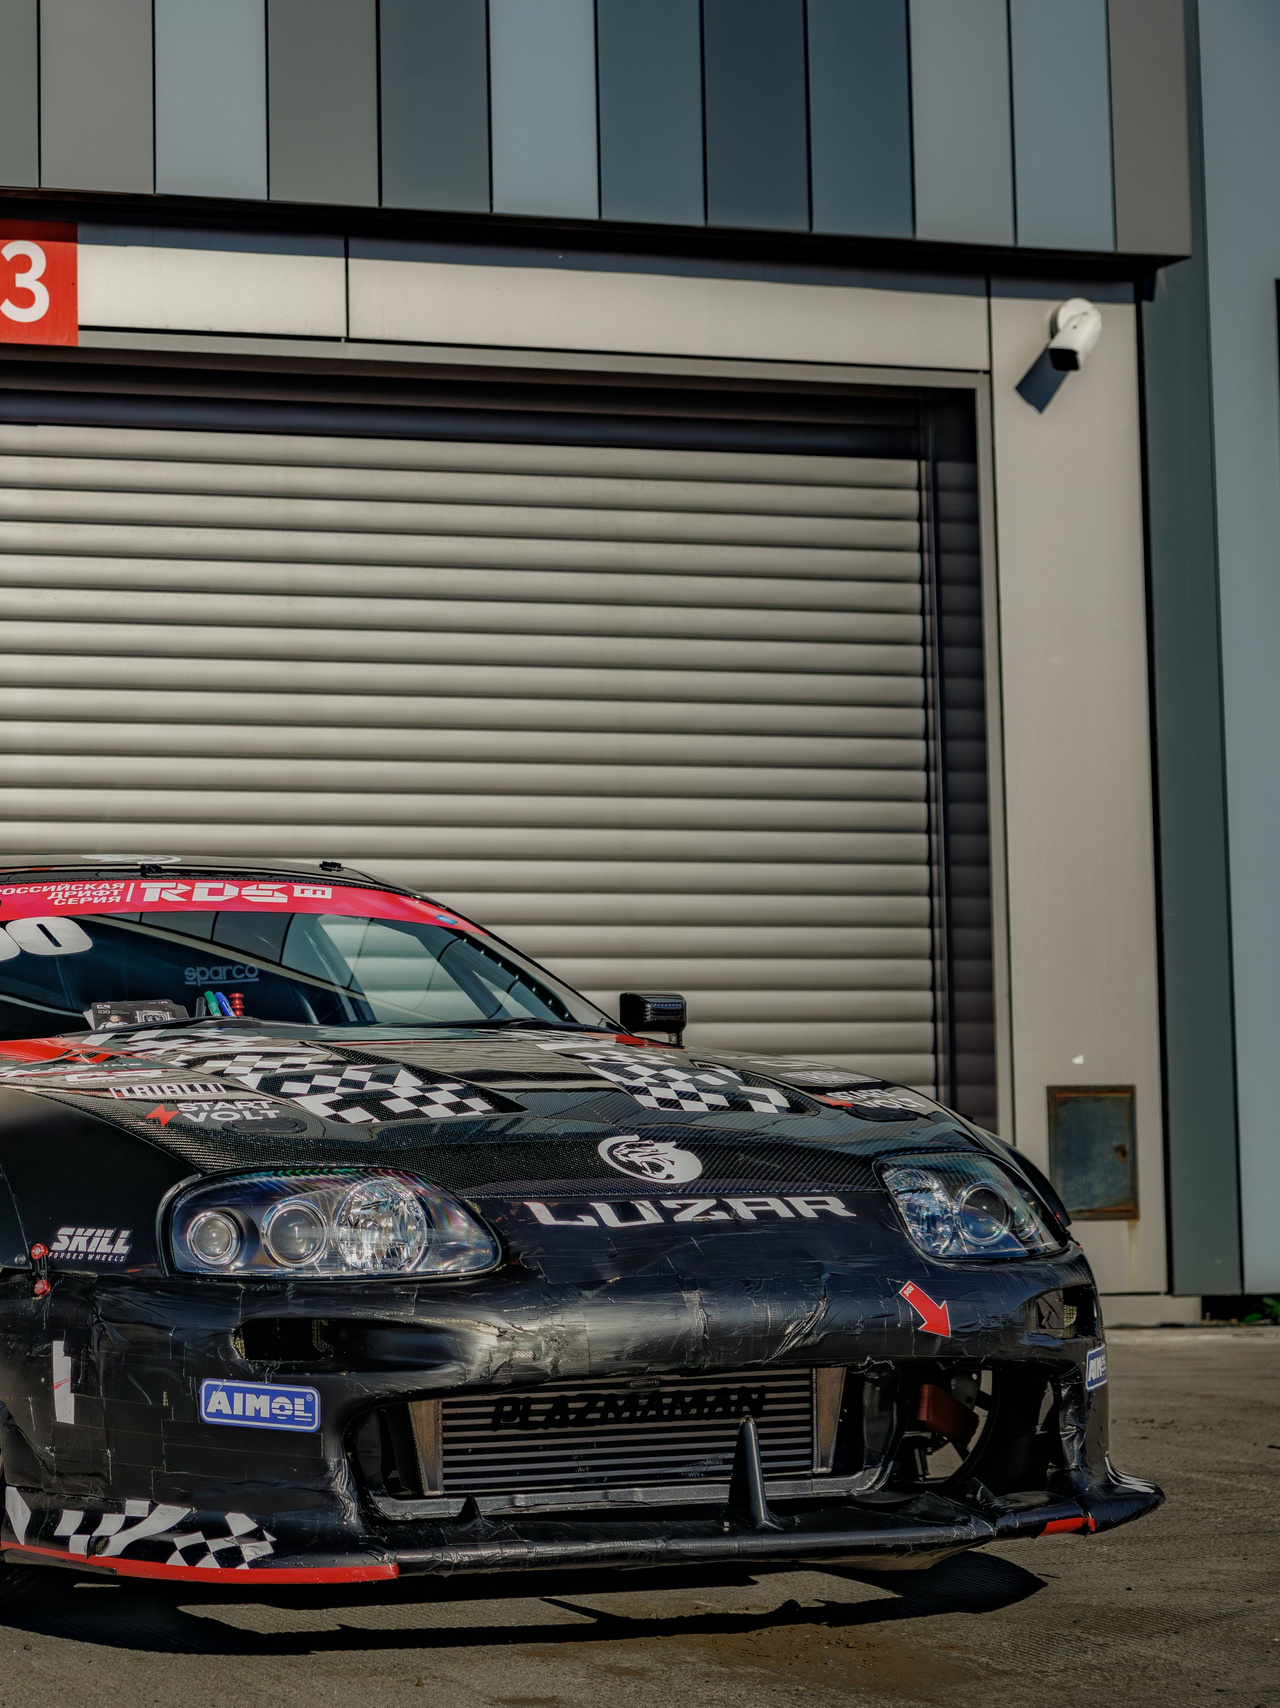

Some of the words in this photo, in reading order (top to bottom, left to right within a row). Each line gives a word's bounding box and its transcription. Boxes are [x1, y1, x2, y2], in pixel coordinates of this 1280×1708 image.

[47, 889, 123, 900] ДРИФТ
[53, 896, 121, 906] СЕРИЯ
[140, 882, 289, 904] RDS
[184, 964, 260, 987] sparco
[112, 1083, 225, 1099] TRIALLI
[176, 1101, 273, 1112] START
[181, 1110, 281, 1123] VOLT
[523, 1195, 857, 1228] LUZAR
[51, 1227, 131, 1254] SKILL
[48, 1252, 85, 1260] FORGED
[87, 1254, 126, 1262] WHEELS
[206, 1390, 313, 1422] AIMOL
